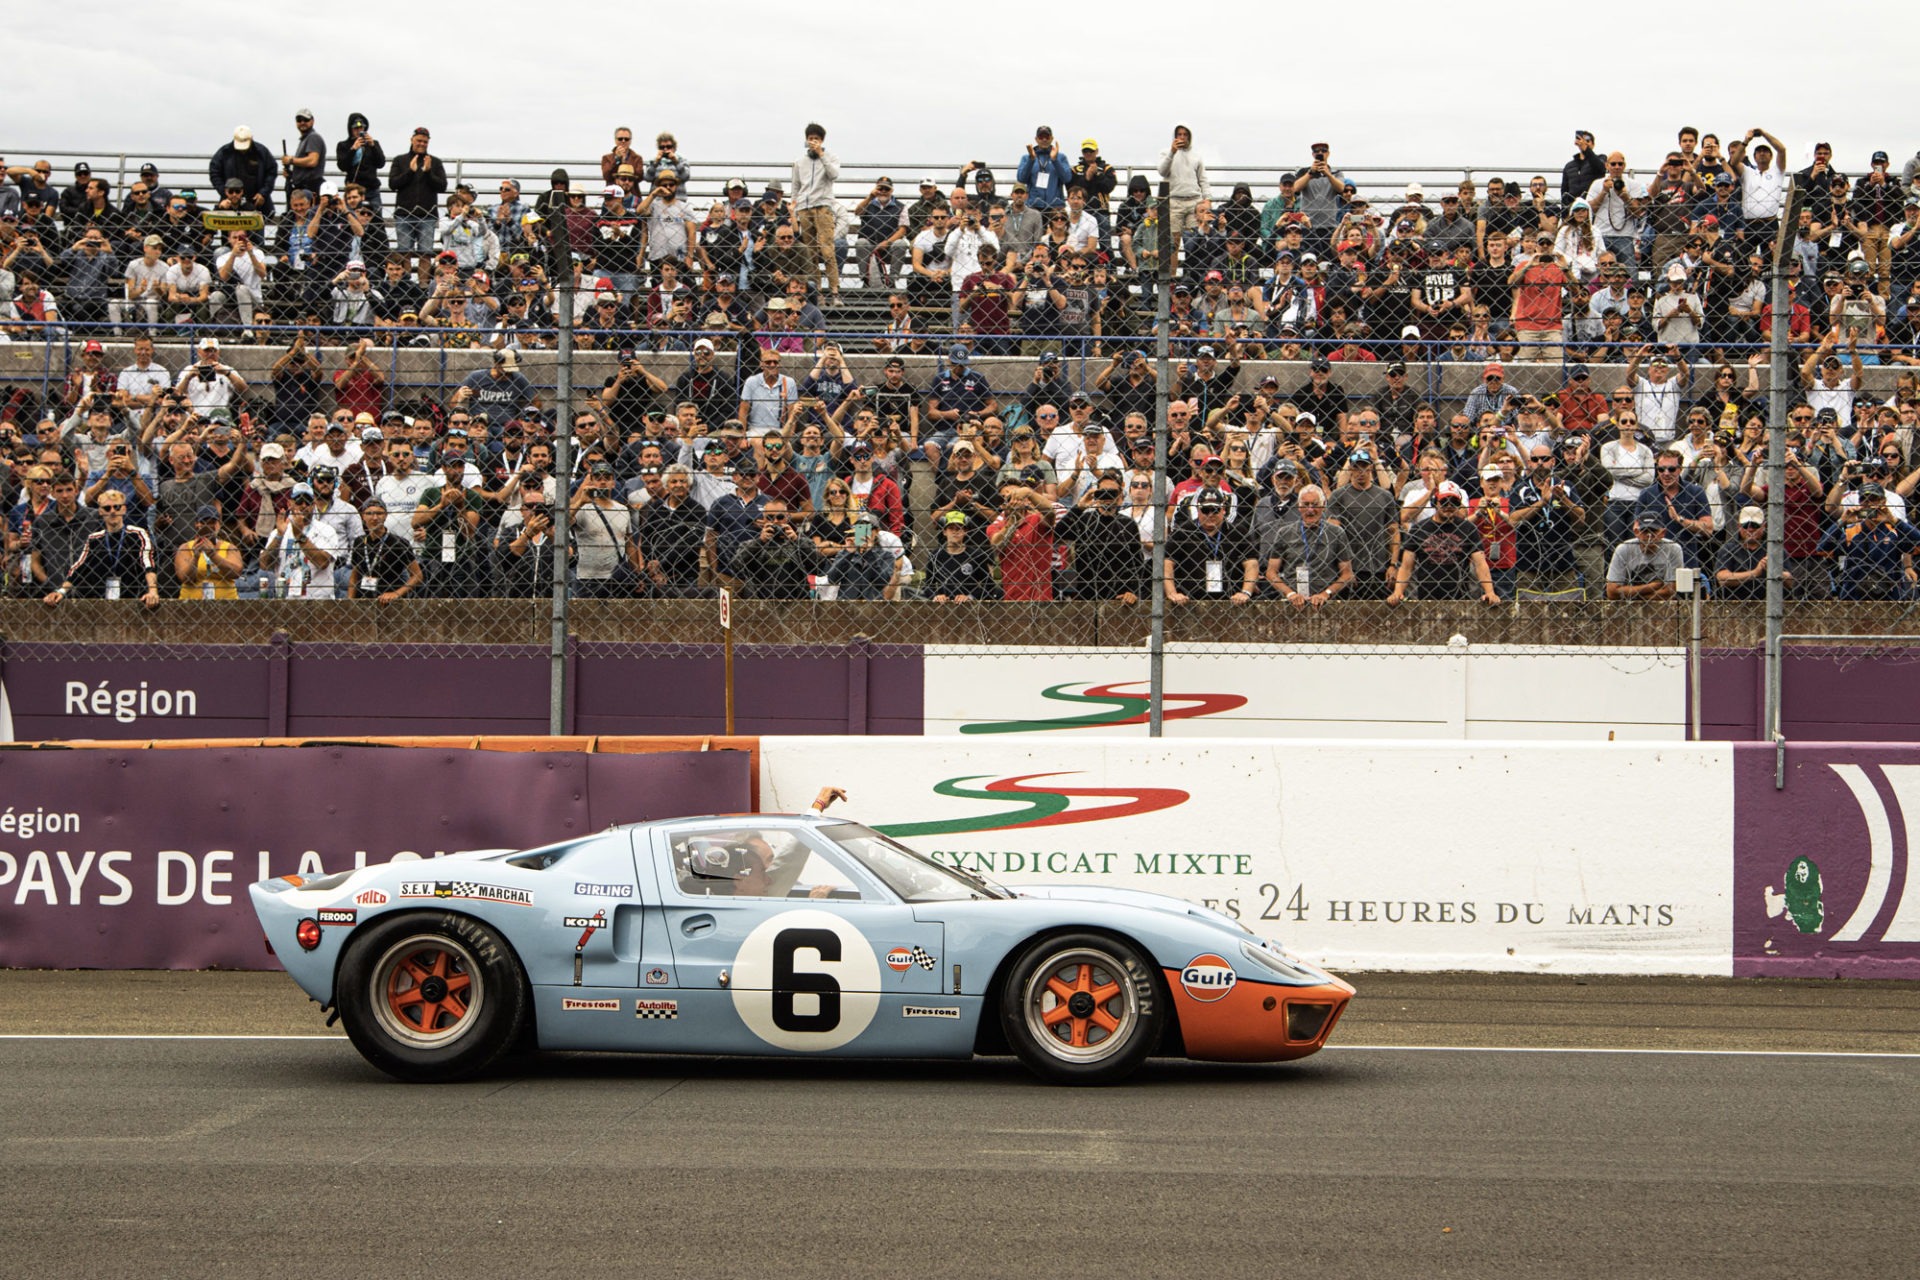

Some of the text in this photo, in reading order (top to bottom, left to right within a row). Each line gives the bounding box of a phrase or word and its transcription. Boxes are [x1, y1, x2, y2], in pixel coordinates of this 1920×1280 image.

[478, 389, 513, 402] SUPPLY
[66, 681, 197, 723] Région
[931, 851, 1253, 875] SYNDICAT MIXTE
[157, 851, 234, 906] DE
[356, 890, 387, 904] TRICO
[401, 885, 531, 903] S.E.V. MARCHAL
[576, 883, 632, 897] GIRLING
[1259, 883, 1310, 921] 24
[1327, 901, 1478, 925] HEURES
[1495, 903, 1545, 925] DU
[1566, 904, 1675, 927] MANS
[319, 912, 354, 922] FERODO
[565, 918, 606, 928] KONI
[887, 954, 915, 964] Gulf
[772, 928, 842, 1033] 6
[1184, 969, 1233, 985] Gulf
[565, 1001, 618, 1009] Firestone
[638, 1001, 676, 1010] Autolite
[905, 1007, 958, 1017] Firestone
